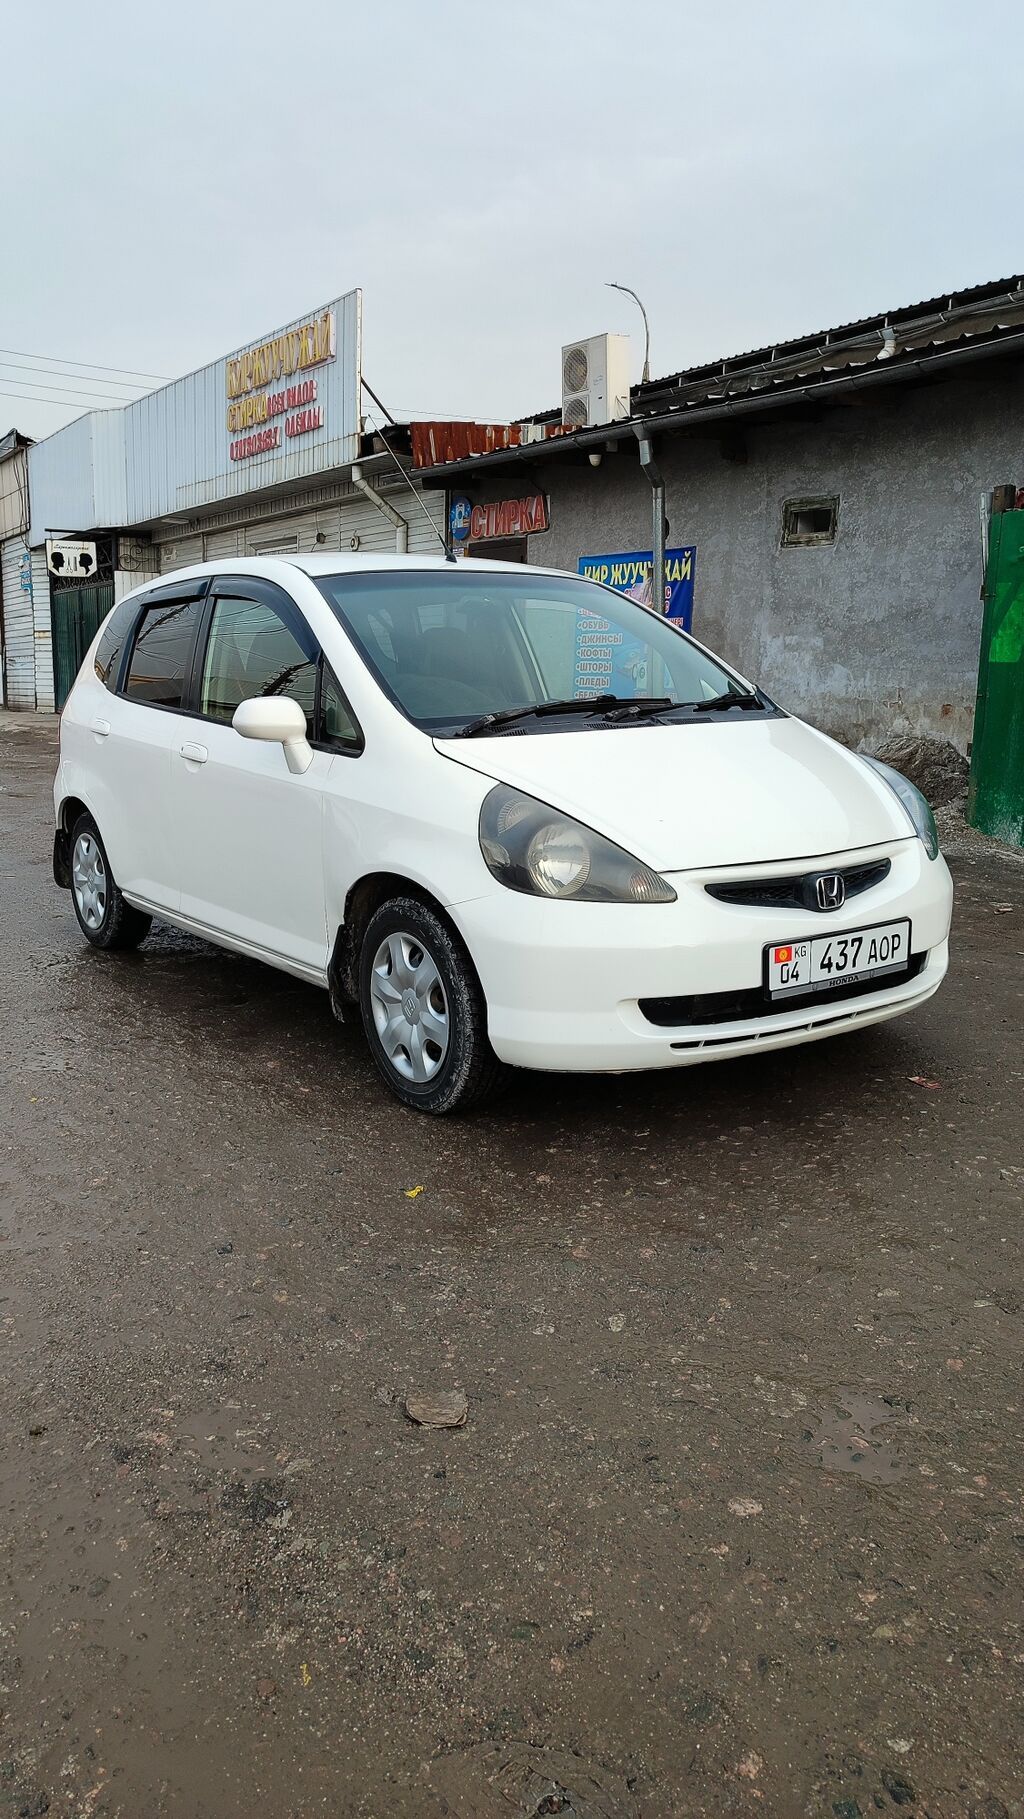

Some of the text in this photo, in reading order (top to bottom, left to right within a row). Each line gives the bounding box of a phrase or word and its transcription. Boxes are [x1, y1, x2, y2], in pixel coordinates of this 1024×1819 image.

[227, 392, 269, 433] СТИРКА
[285, 406, 323, 438] ОДЕЖДЫ
[471, 495, 546, 538] СТИРКА
[581, 621, 609, 630] ОБУВЬ
[581, 634, 622, 645] ДЖИНСЫ
[580, 648, 611, 658] КОФТЫ
[579, 662, 612, 672] ШТОРЫ
[579, 677, 609, 688] ПЛЕДЫ
[794, 945, 807, 959] KG
[819, 933, 901, 974] 437 AOP
[780, 961, 800, 984] 04
[829, 974, 859, 987] HONDA
